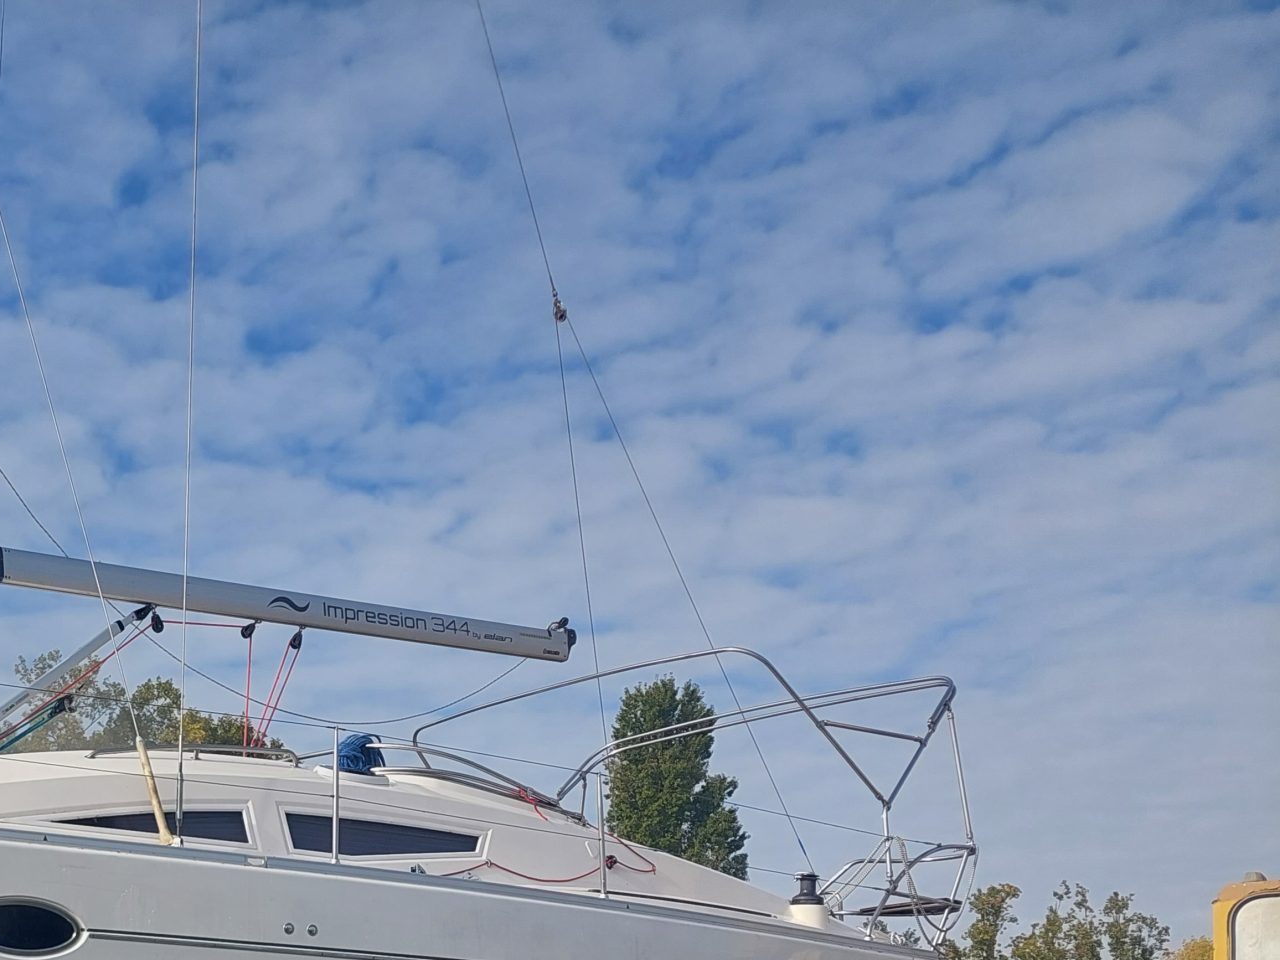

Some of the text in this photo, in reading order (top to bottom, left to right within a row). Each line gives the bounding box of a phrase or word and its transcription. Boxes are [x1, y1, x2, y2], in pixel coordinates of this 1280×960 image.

[322, 601, 427, 631] Impression
[431, 616, 471, 637] 344
[472, 631, 481, 640] by
[483, 633, 513, 643] elan
